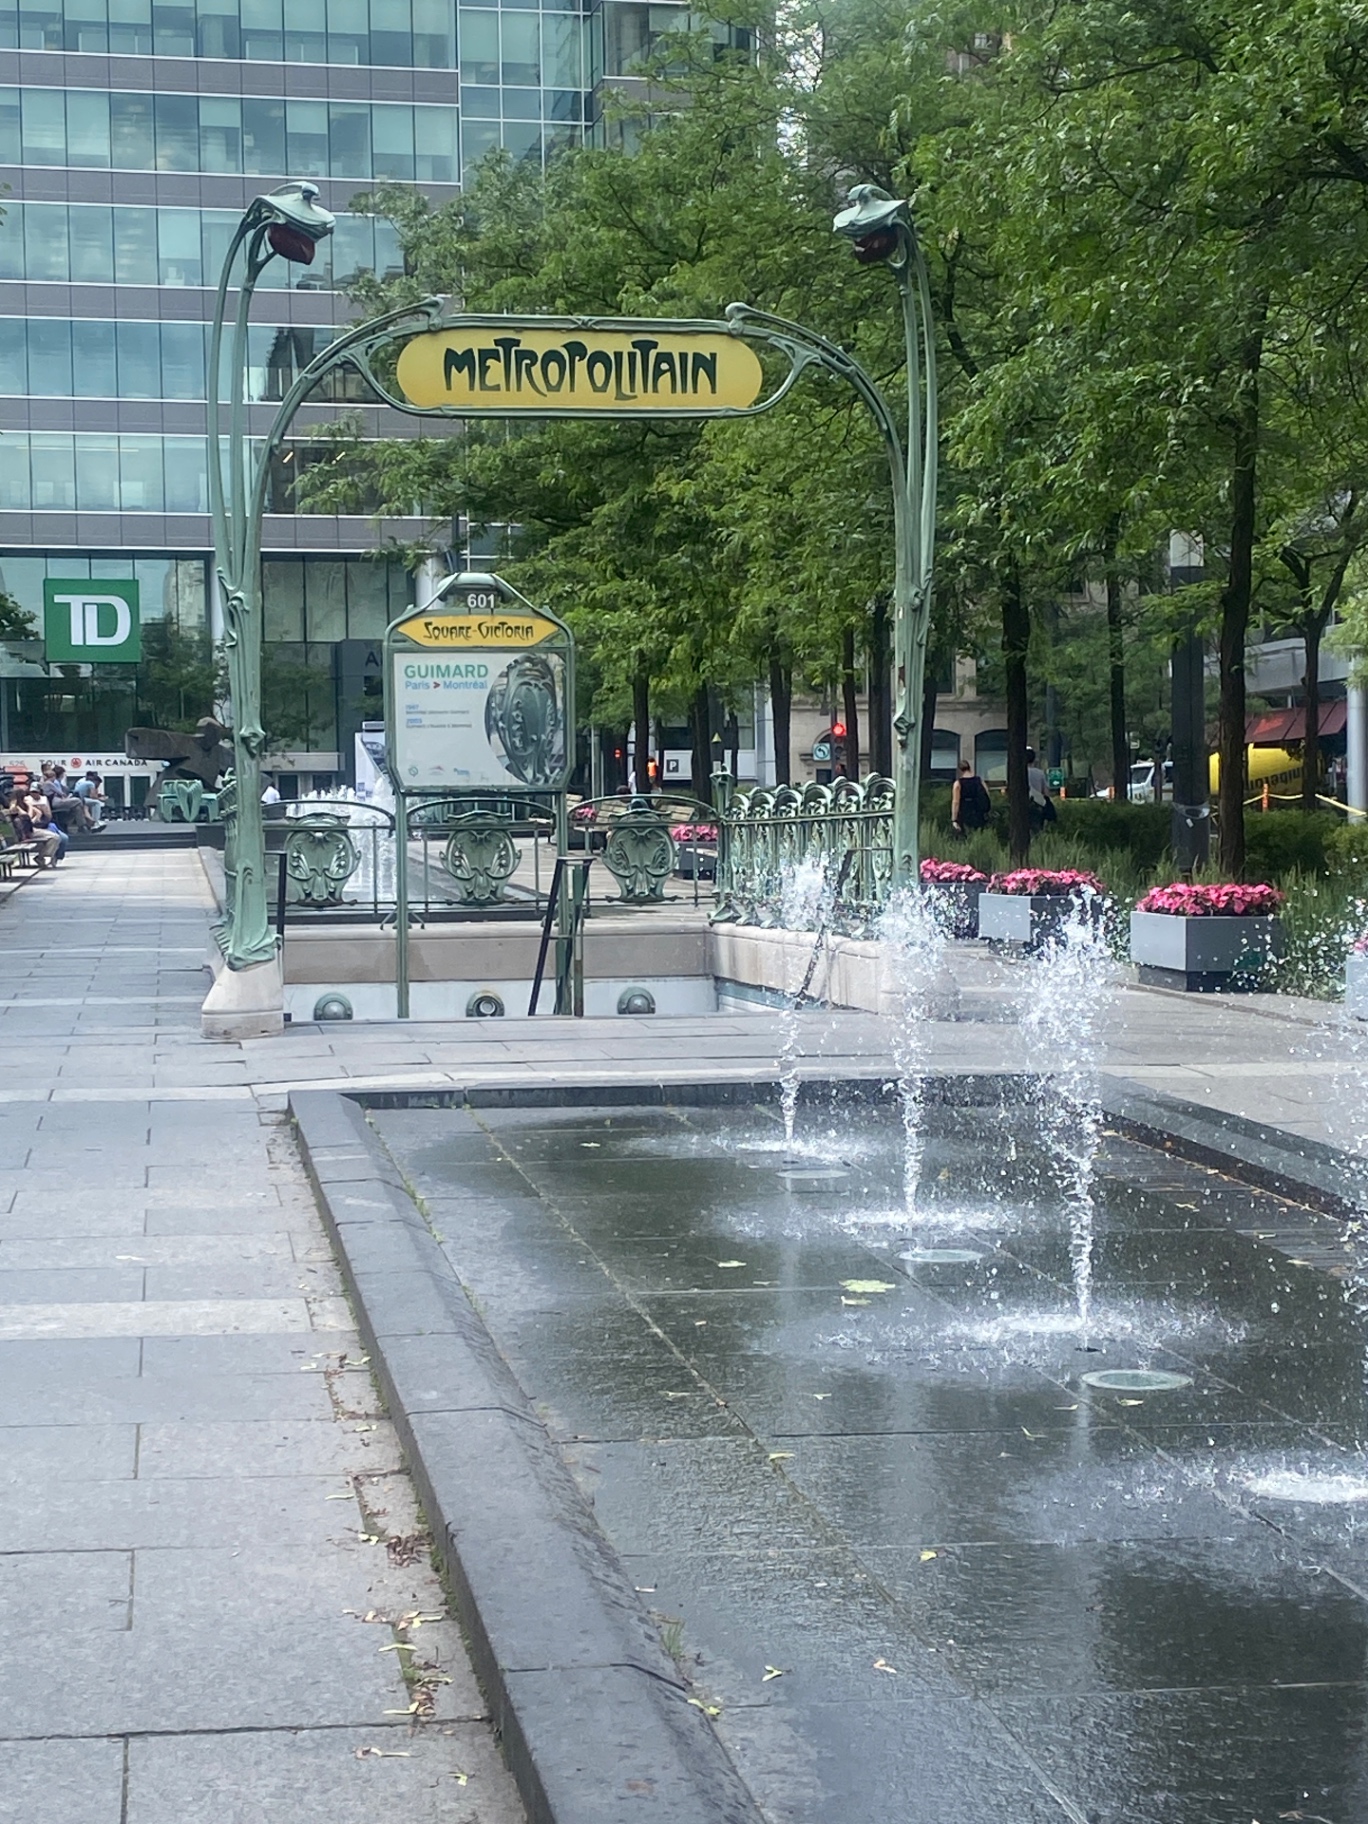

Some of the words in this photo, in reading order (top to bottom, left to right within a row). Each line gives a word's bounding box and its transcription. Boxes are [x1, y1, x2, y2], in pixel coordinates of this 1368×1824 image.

[443, 337, 717, 400] METROPOLITAIN
[467, 594, 495, 608] 601
[53, 594, 132, 646] TD
[404, 664, 489, 679] GUIMARD
[405, 680, 430, 690] Paris
[443, 680, 488, 690] Montréal
[85, 759, 103, 767] AIR
[104, 759, 148, 767] CANADA
